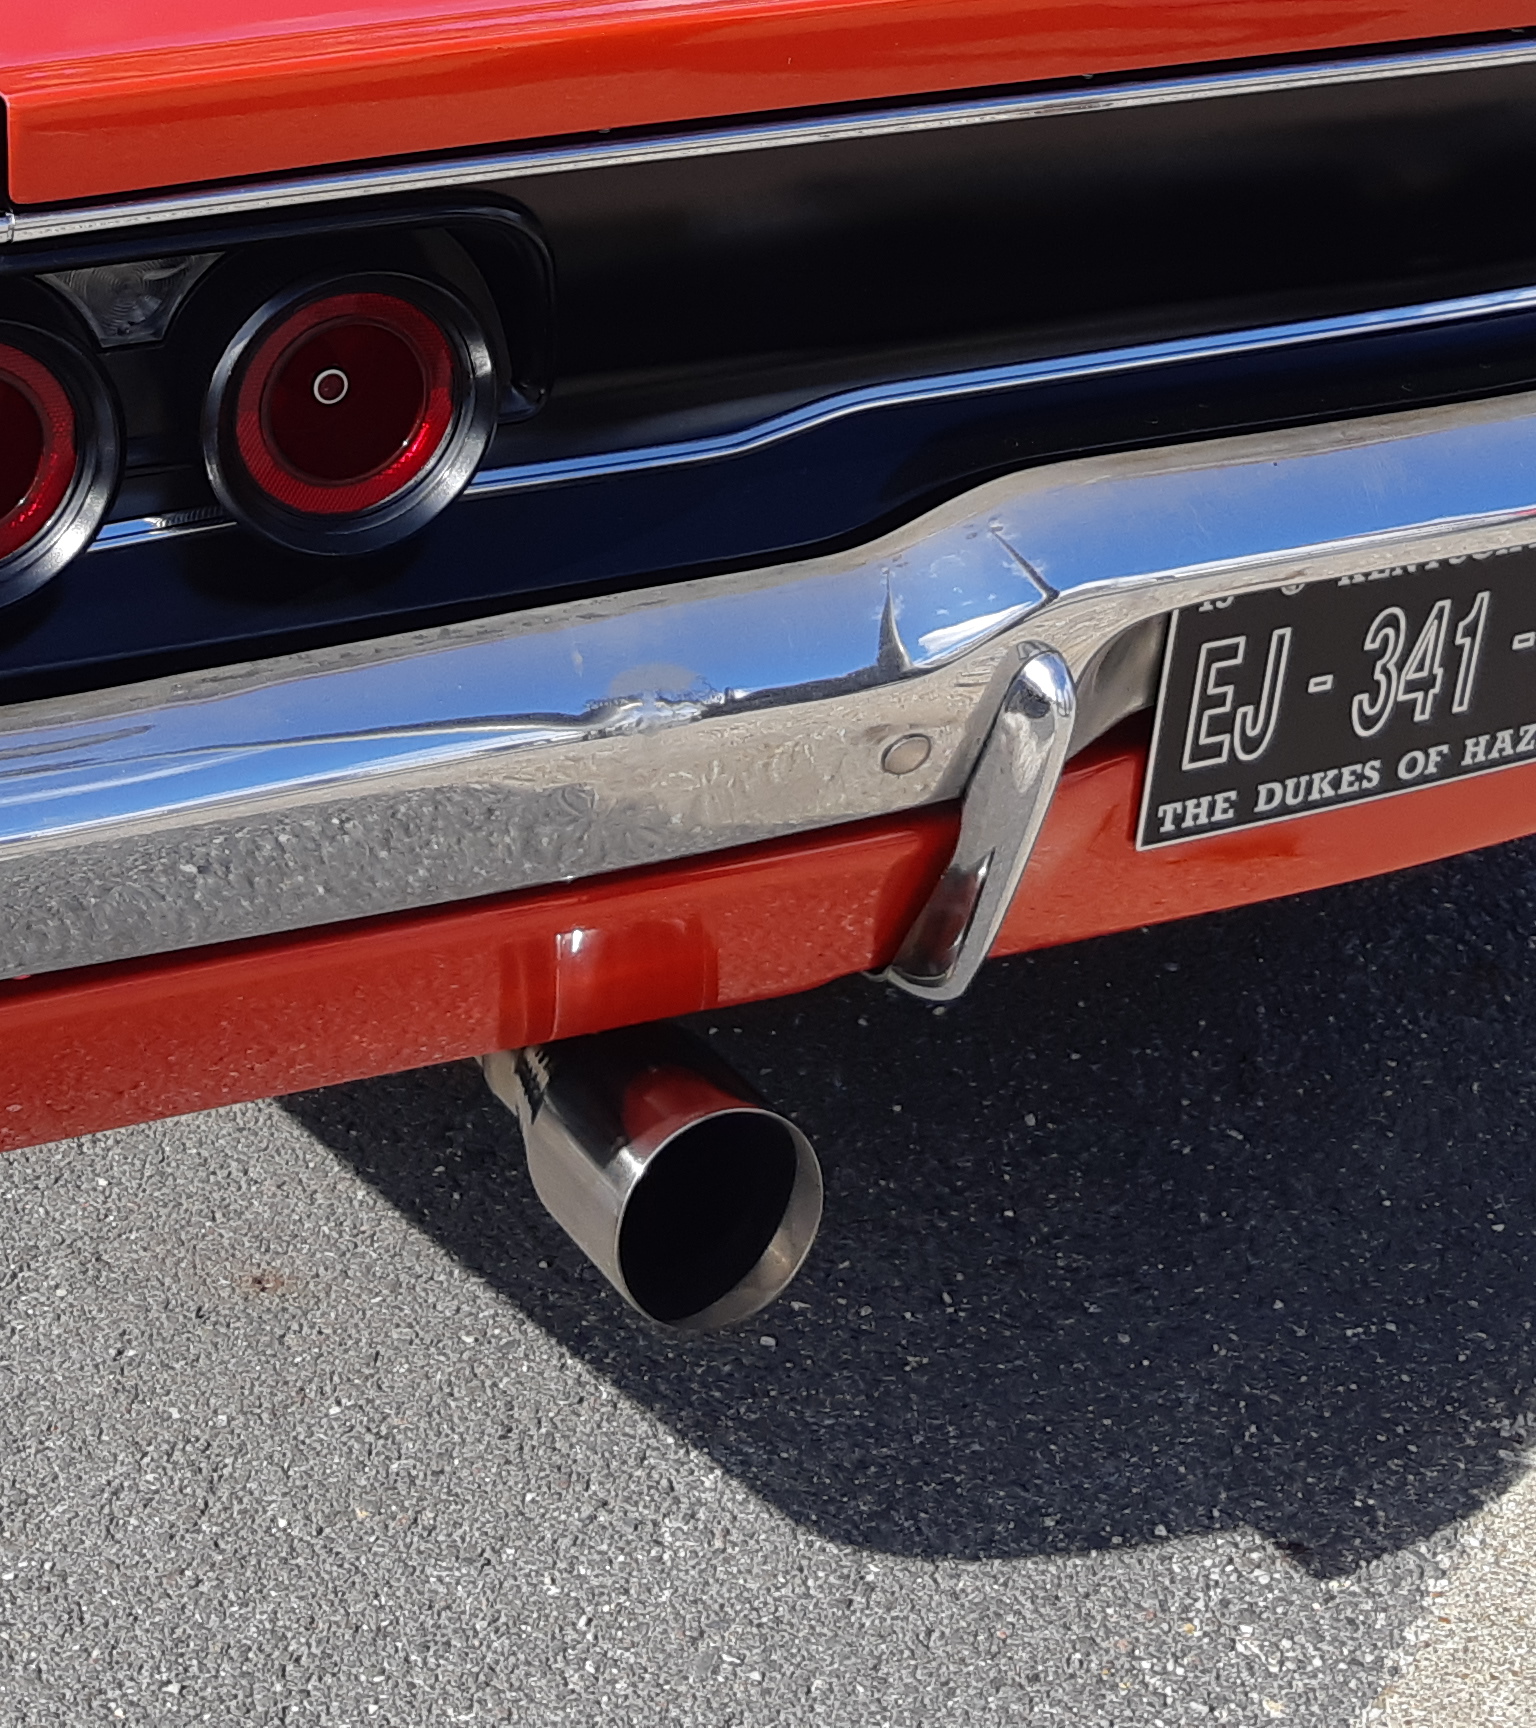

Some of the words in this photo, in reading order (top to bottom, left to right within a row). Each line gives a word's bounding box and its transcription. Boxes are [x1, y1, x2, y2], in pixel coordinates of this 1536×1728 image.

[1181, 626, 1292, 771] EJ
[1351, 590, 1491, 738] 341
[1157, 790, 1238, 833] THE
[1253, 759, 1382, 813] DUKES
[1397, 744, 1450, 780] OF
